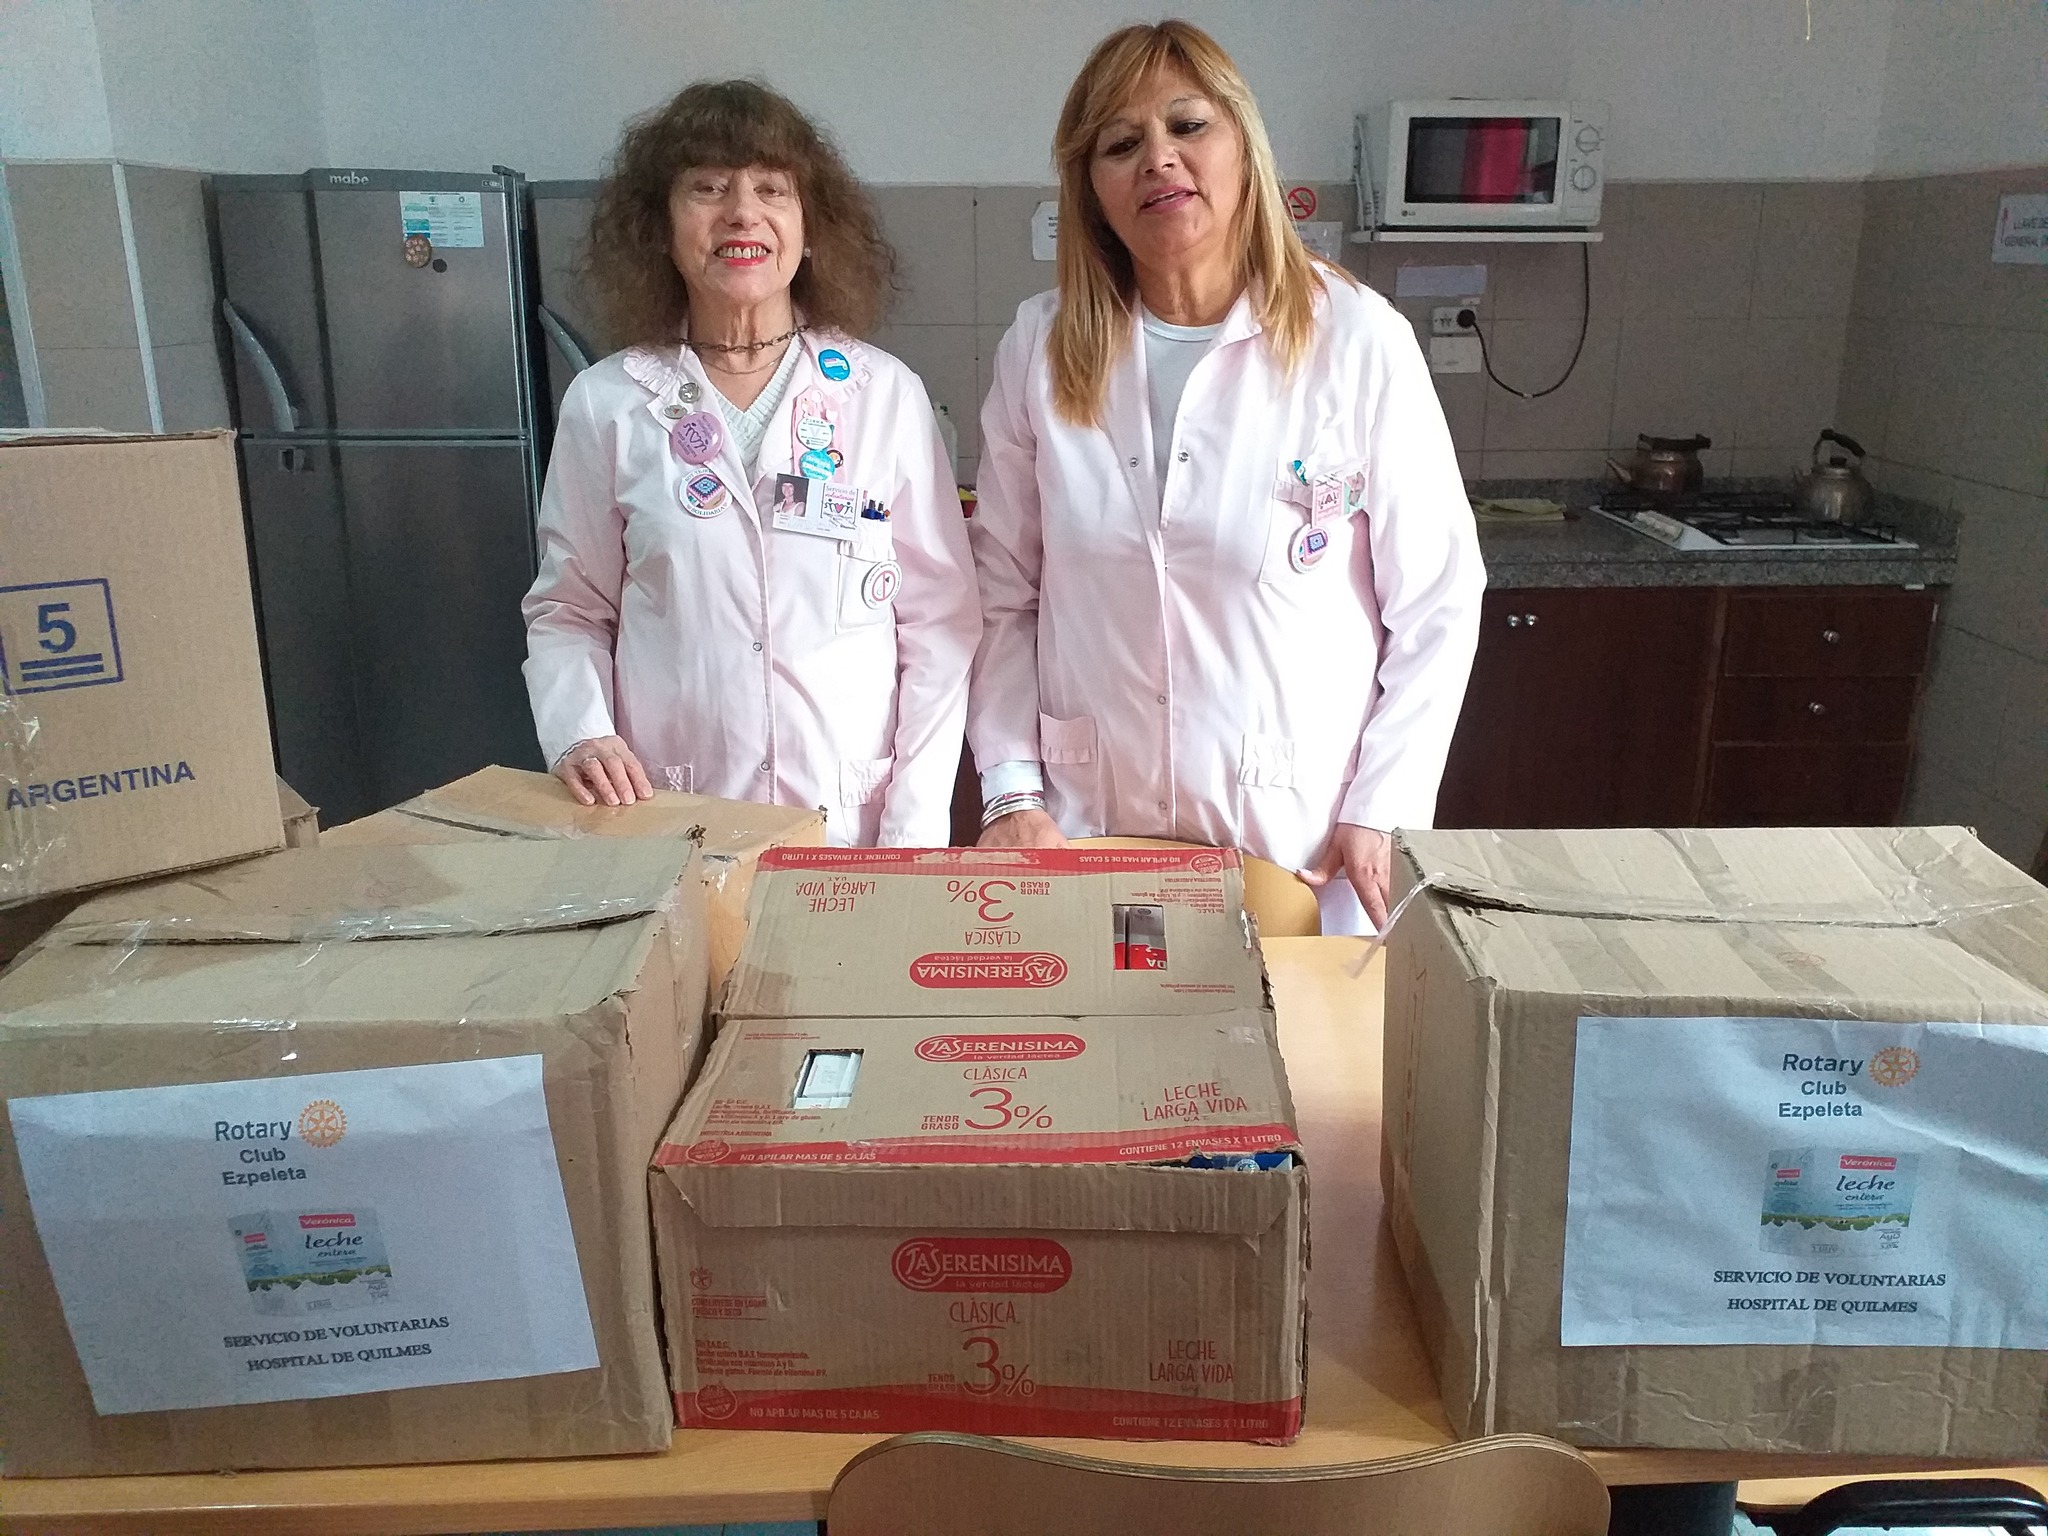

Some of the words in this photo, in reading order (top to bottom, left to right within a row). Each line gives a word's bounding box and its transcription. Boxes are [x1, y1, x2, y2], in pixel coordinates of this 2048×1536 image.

[330, 171, 369, 185] mabe
[38, 602, 76, 653] 5
[6, 761, 196, 811] ARGENTINA
[782, 853, 804, 861] LITRO
[812, 853, 817, 861] X
[818, 853, 853, 861] ENVASES
[854, 853, 862, 861] 12
[864, 853, 901, 861] CONTIENE
[796, 882, 825, 896] VIDA
[833, 881, 876, 896] LARGA
[1020, 881, 1051, 889] GRASO
[809, 898, 855, 913] LECHE
[947, 880, 1016, 922] 3%
[965, 931, 1021, 947] CLÁSICA
[1782, 1053, 1863, 1076] Rotary
[963, 1066, 1028, 1081] CLÁSICA
[1164, 1082, 1221, 1102] LECHE
[1801, 1081, 1847, 1095] Club
[965, 1087, 1053, 1130] 3%
[1144, 1101, 1199, 1121] LARGA
[1206, 1096, 1247, 1114] VIDA
[1779, 1102, 1862, 1120] Ezpeleta
[921, 1122, 959, 1130] GRASO
[923, 1115, 960, 1123] TENOR
[215, 1121, 292, 1141] Rotary
[1119, 1144, 1168, 1156] CONTIENE
[1186, 1136, 1231, 1148] ENVASES
[1233, 1136, 1240, 1144] X
[1252, 1134, 1282, 1143] LITRO
[240, 1147, 286, 1163] Club
[844, 1152, 876, 1160] CAJAS
[222, 1167, 307, 1186] Ezpeleta
[1836, 1174, 1896, 1191] leche
[1845, 1192, 1885, 1201] entera
[305, 1231, 364, 1250] leche
[317, 1248, 358, 1258] entera
[970, 1279, 1009, 1289] verdad
[1713, 1270, 1792, 1283] SERVICIO
[1795, 1271, 1820, 1283] DE
[1824, 1272, 1946, 1287] VOLUNTARIAS
[950, 1297, 1017, 1324] CLÁSICA
[1727, 1298, 1810, 1310] HOSPITAL
[1813, 1299, 1838, 1311] DE
[1841, 1301, 1918, 1314] QUILMES
[223, 1331, 300, 1348] SERVICIO
[304, 1328, 328, 1342] DE
[329, 1316, 450, 1339] VOLUNTARIAS
[248, 1356, 329, 1372] HOSPITAL
[332, 1351, 355, 1364] DE
[357, 1343, 433, 1363] QUILMES
[1168, 1339, 1216, 1360] LECHE
[962, 1336, 1036, 1395] 3%
[1150, 1362, 1196, 1382] LARGA
[1202, 1363, 1234, 1383] VIDA
[928, 1373, 955, 1383] TENOR
[750, 1407, 764, 1417] NO
[766, 1407, 801, 1418] APILAR
[803, 1408, 824, 1418] MAS
[825, 1409, 839, 1419] DE
[849, 1410, 880, 1420] CAJAS
[1112, 1416, 1161, 1428] CONTIENE
[1164, 1418, 1176, 1428] 12
[1240, 1419, 1269, 1429] LITRO
